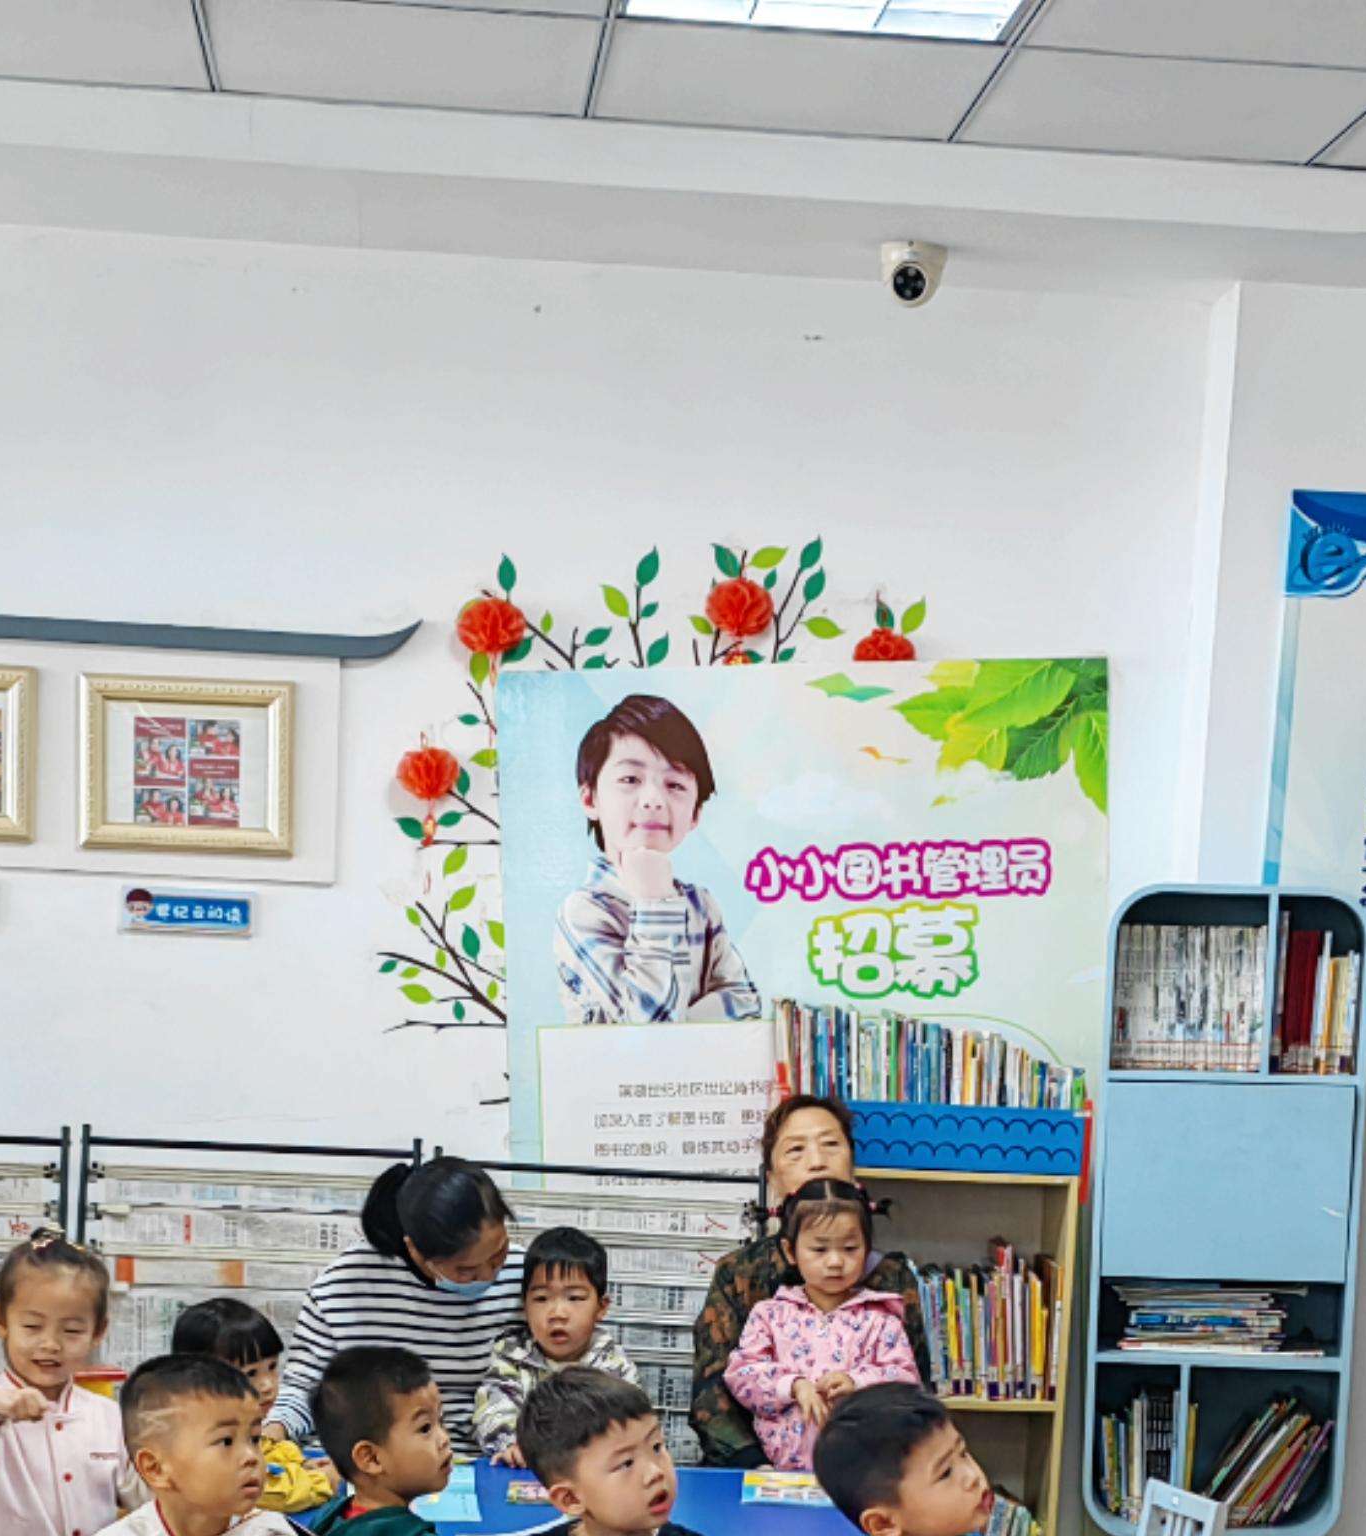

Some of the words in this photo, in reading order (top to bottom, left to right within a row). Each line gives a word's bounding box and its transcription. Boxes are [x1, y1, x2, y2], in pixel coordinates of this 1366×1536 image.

[747, 840, 1050, 900] 小小图书管理员
[809, 903, 978, 998] 招募
